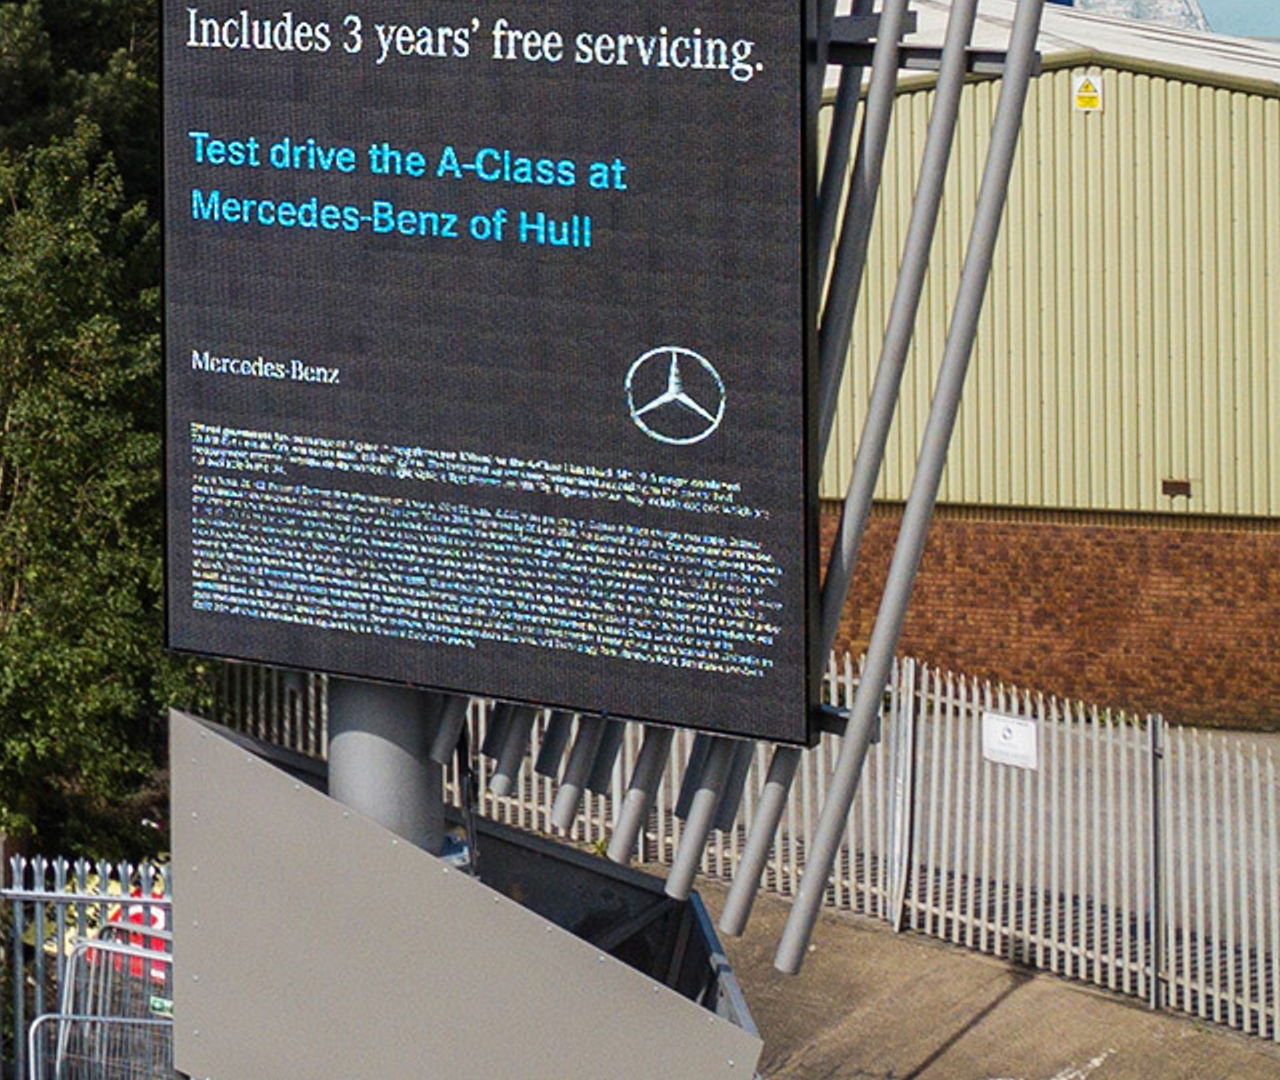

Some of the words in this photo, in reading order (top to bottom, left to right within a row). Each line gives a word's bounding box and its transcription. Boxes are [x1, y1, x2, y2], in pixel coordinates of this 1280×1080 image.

[187, 8, 331, 51] Includes
[344, 15, 362, 53] 3
[375, 18, 479, 64] years'
[493, 19, 562, 61] free
[575, 27, 763, 81] servicing.
[189, 132, 260, 166] Test
[270, 137, 355, 172] drive
[369, 143, 425, 176] the
[437, 147, 575, 185] A-Class
[589, 159, 627, 189] at
[193, 189, 458, 237] Mercedes-Benz
[469, 208, 507, 240] of
[520, 212, 590, 247] Hull
[192, 350, 339, 383] Mercedes-Benz
